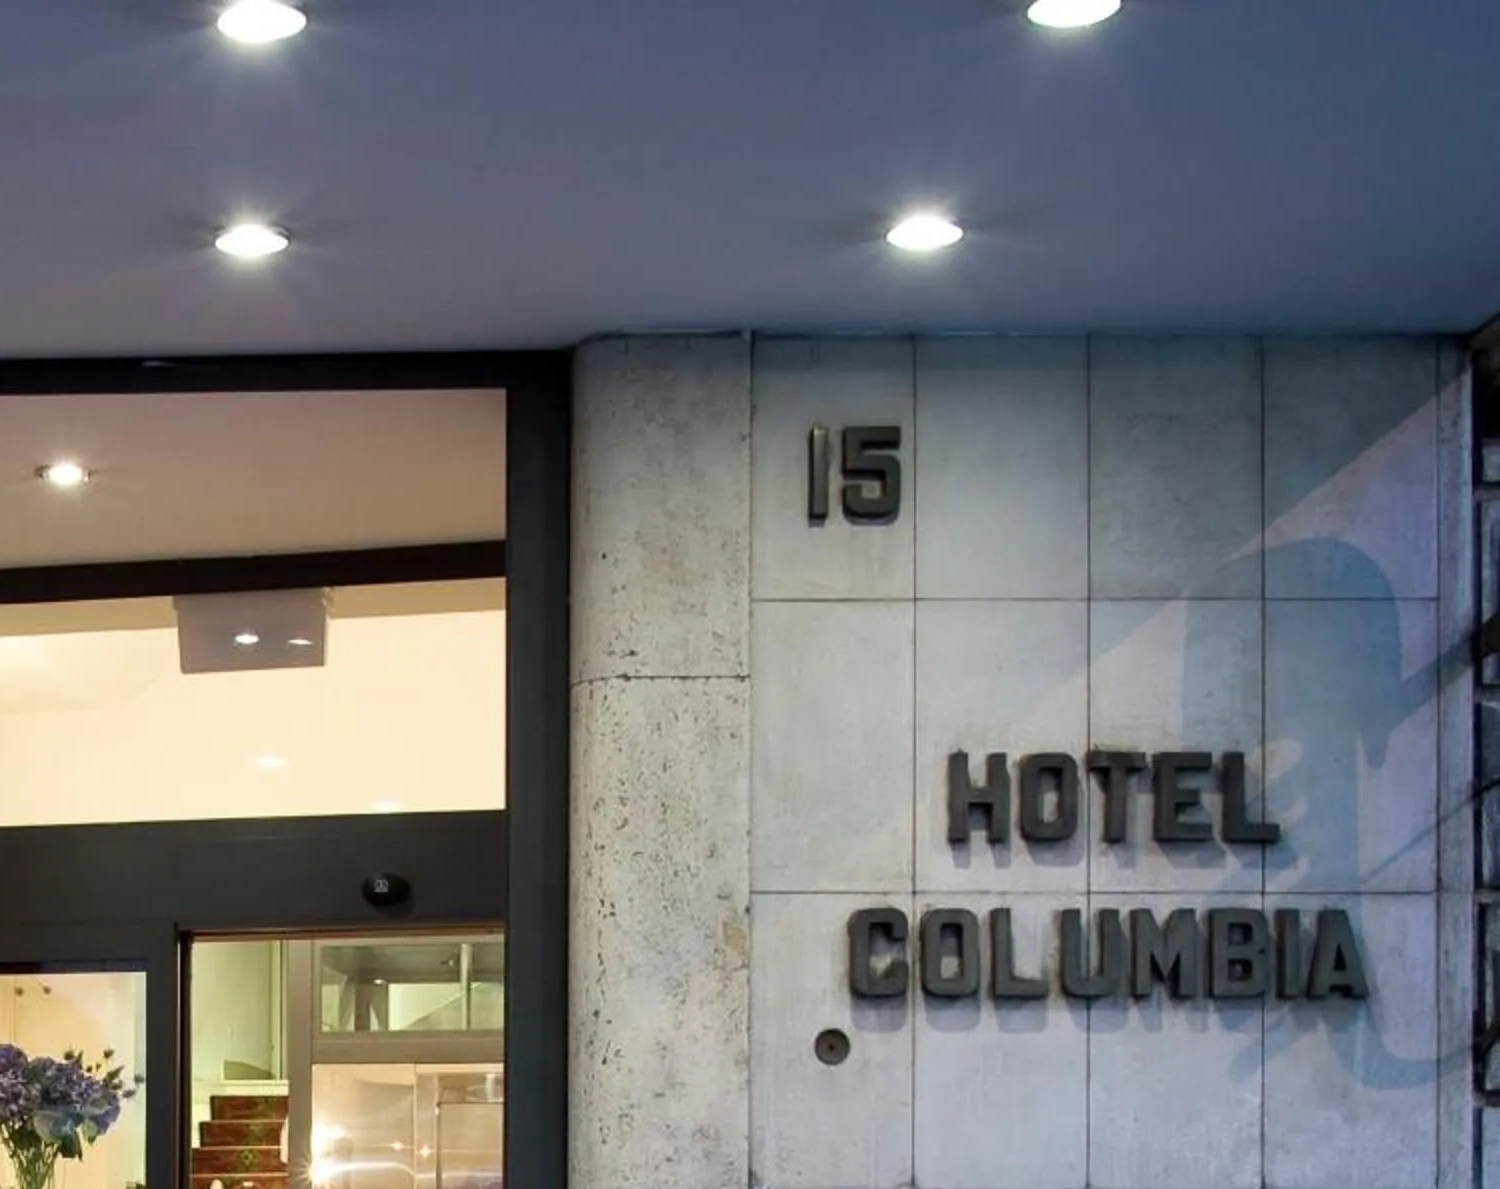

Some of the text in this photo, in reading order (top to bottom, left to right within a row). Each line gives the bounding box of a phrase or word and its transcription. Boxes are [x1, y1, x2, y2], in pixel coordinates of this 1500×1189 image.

[807, 424, 901, 520] 15
[947, 750, 1280, 843] HOTEL
[847, 906, 1369, 1000] COLUMBIA
